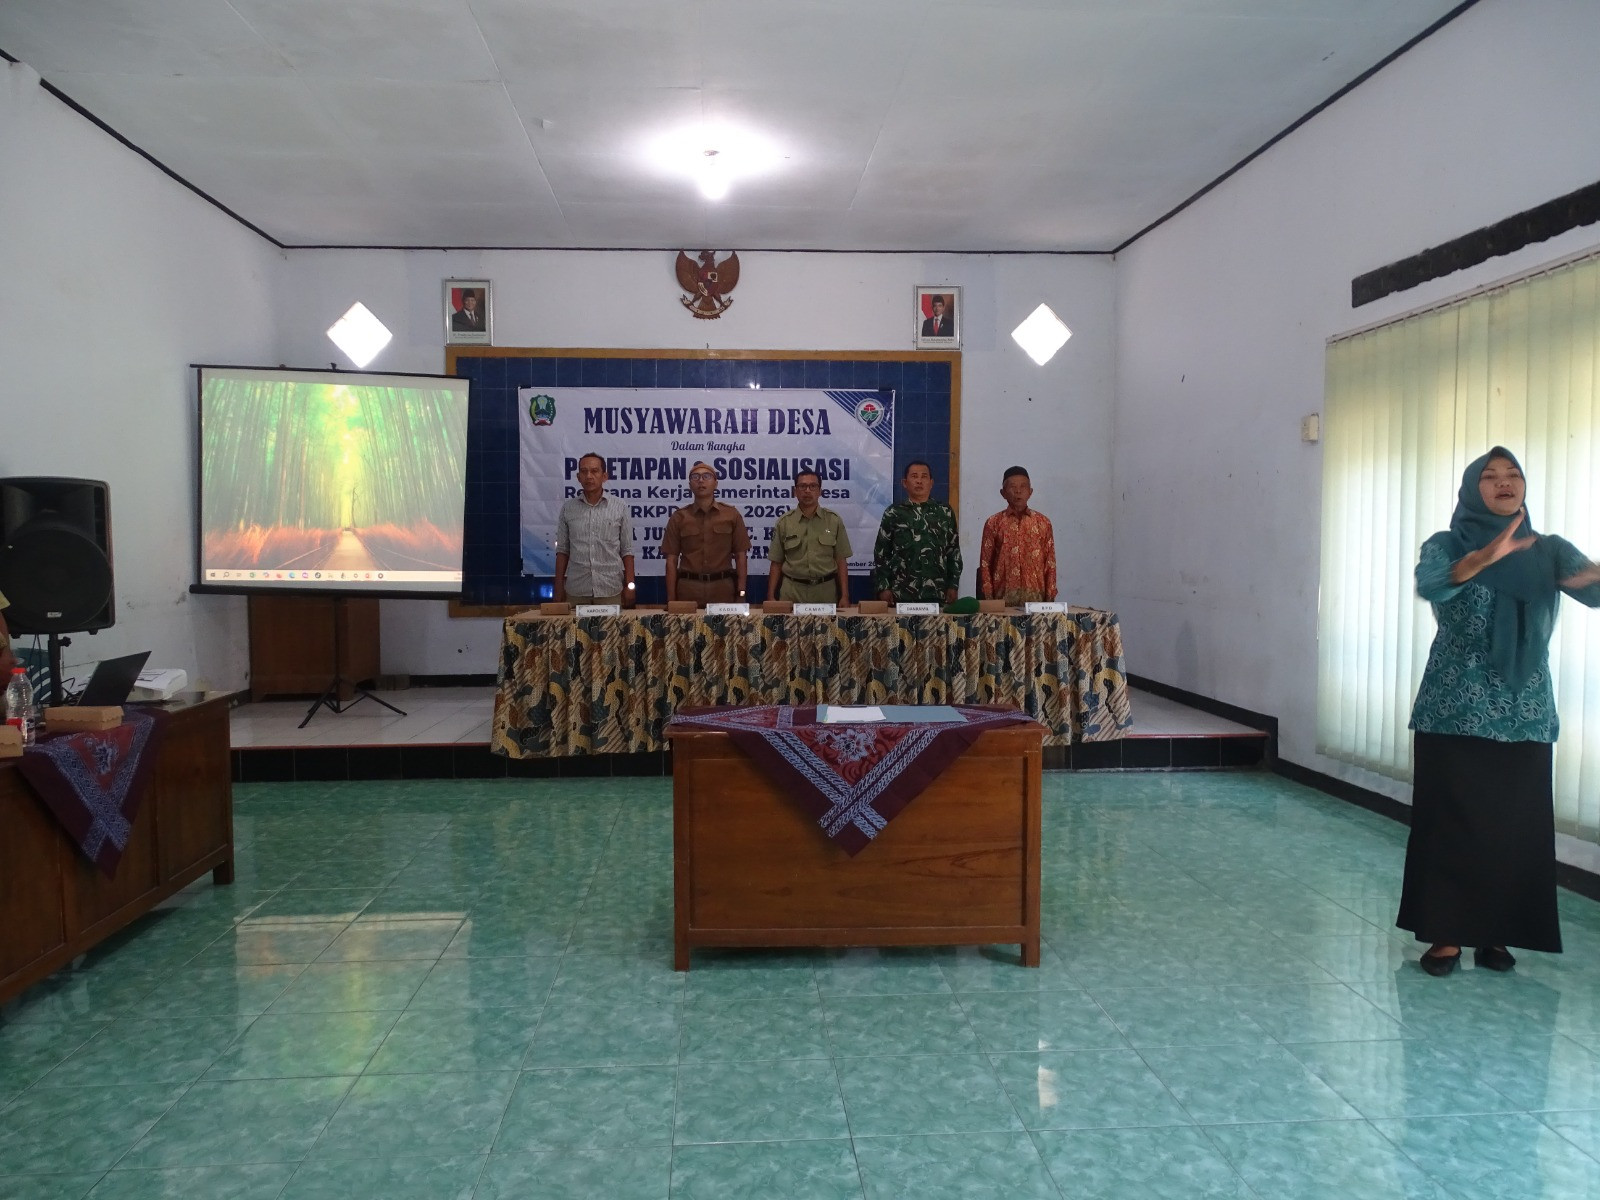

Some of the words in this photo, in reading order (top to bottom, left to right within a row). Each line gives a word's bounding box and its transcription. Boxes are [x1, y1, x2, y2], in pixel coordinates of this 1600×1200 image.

[584, 407, 759, 435] MUSYAWARAH
[768, 408, 831, 435] DESA
[670, 441, 704, 451] Dalam
[706, 441, 746, 454] Rangka
[564, 457, 687, 481] PETAPAN
[713, 457, 850, 481] SOSIALISASI
[647, 484, 693, 501] Kerja
[821, 488, 850, 499] esa
